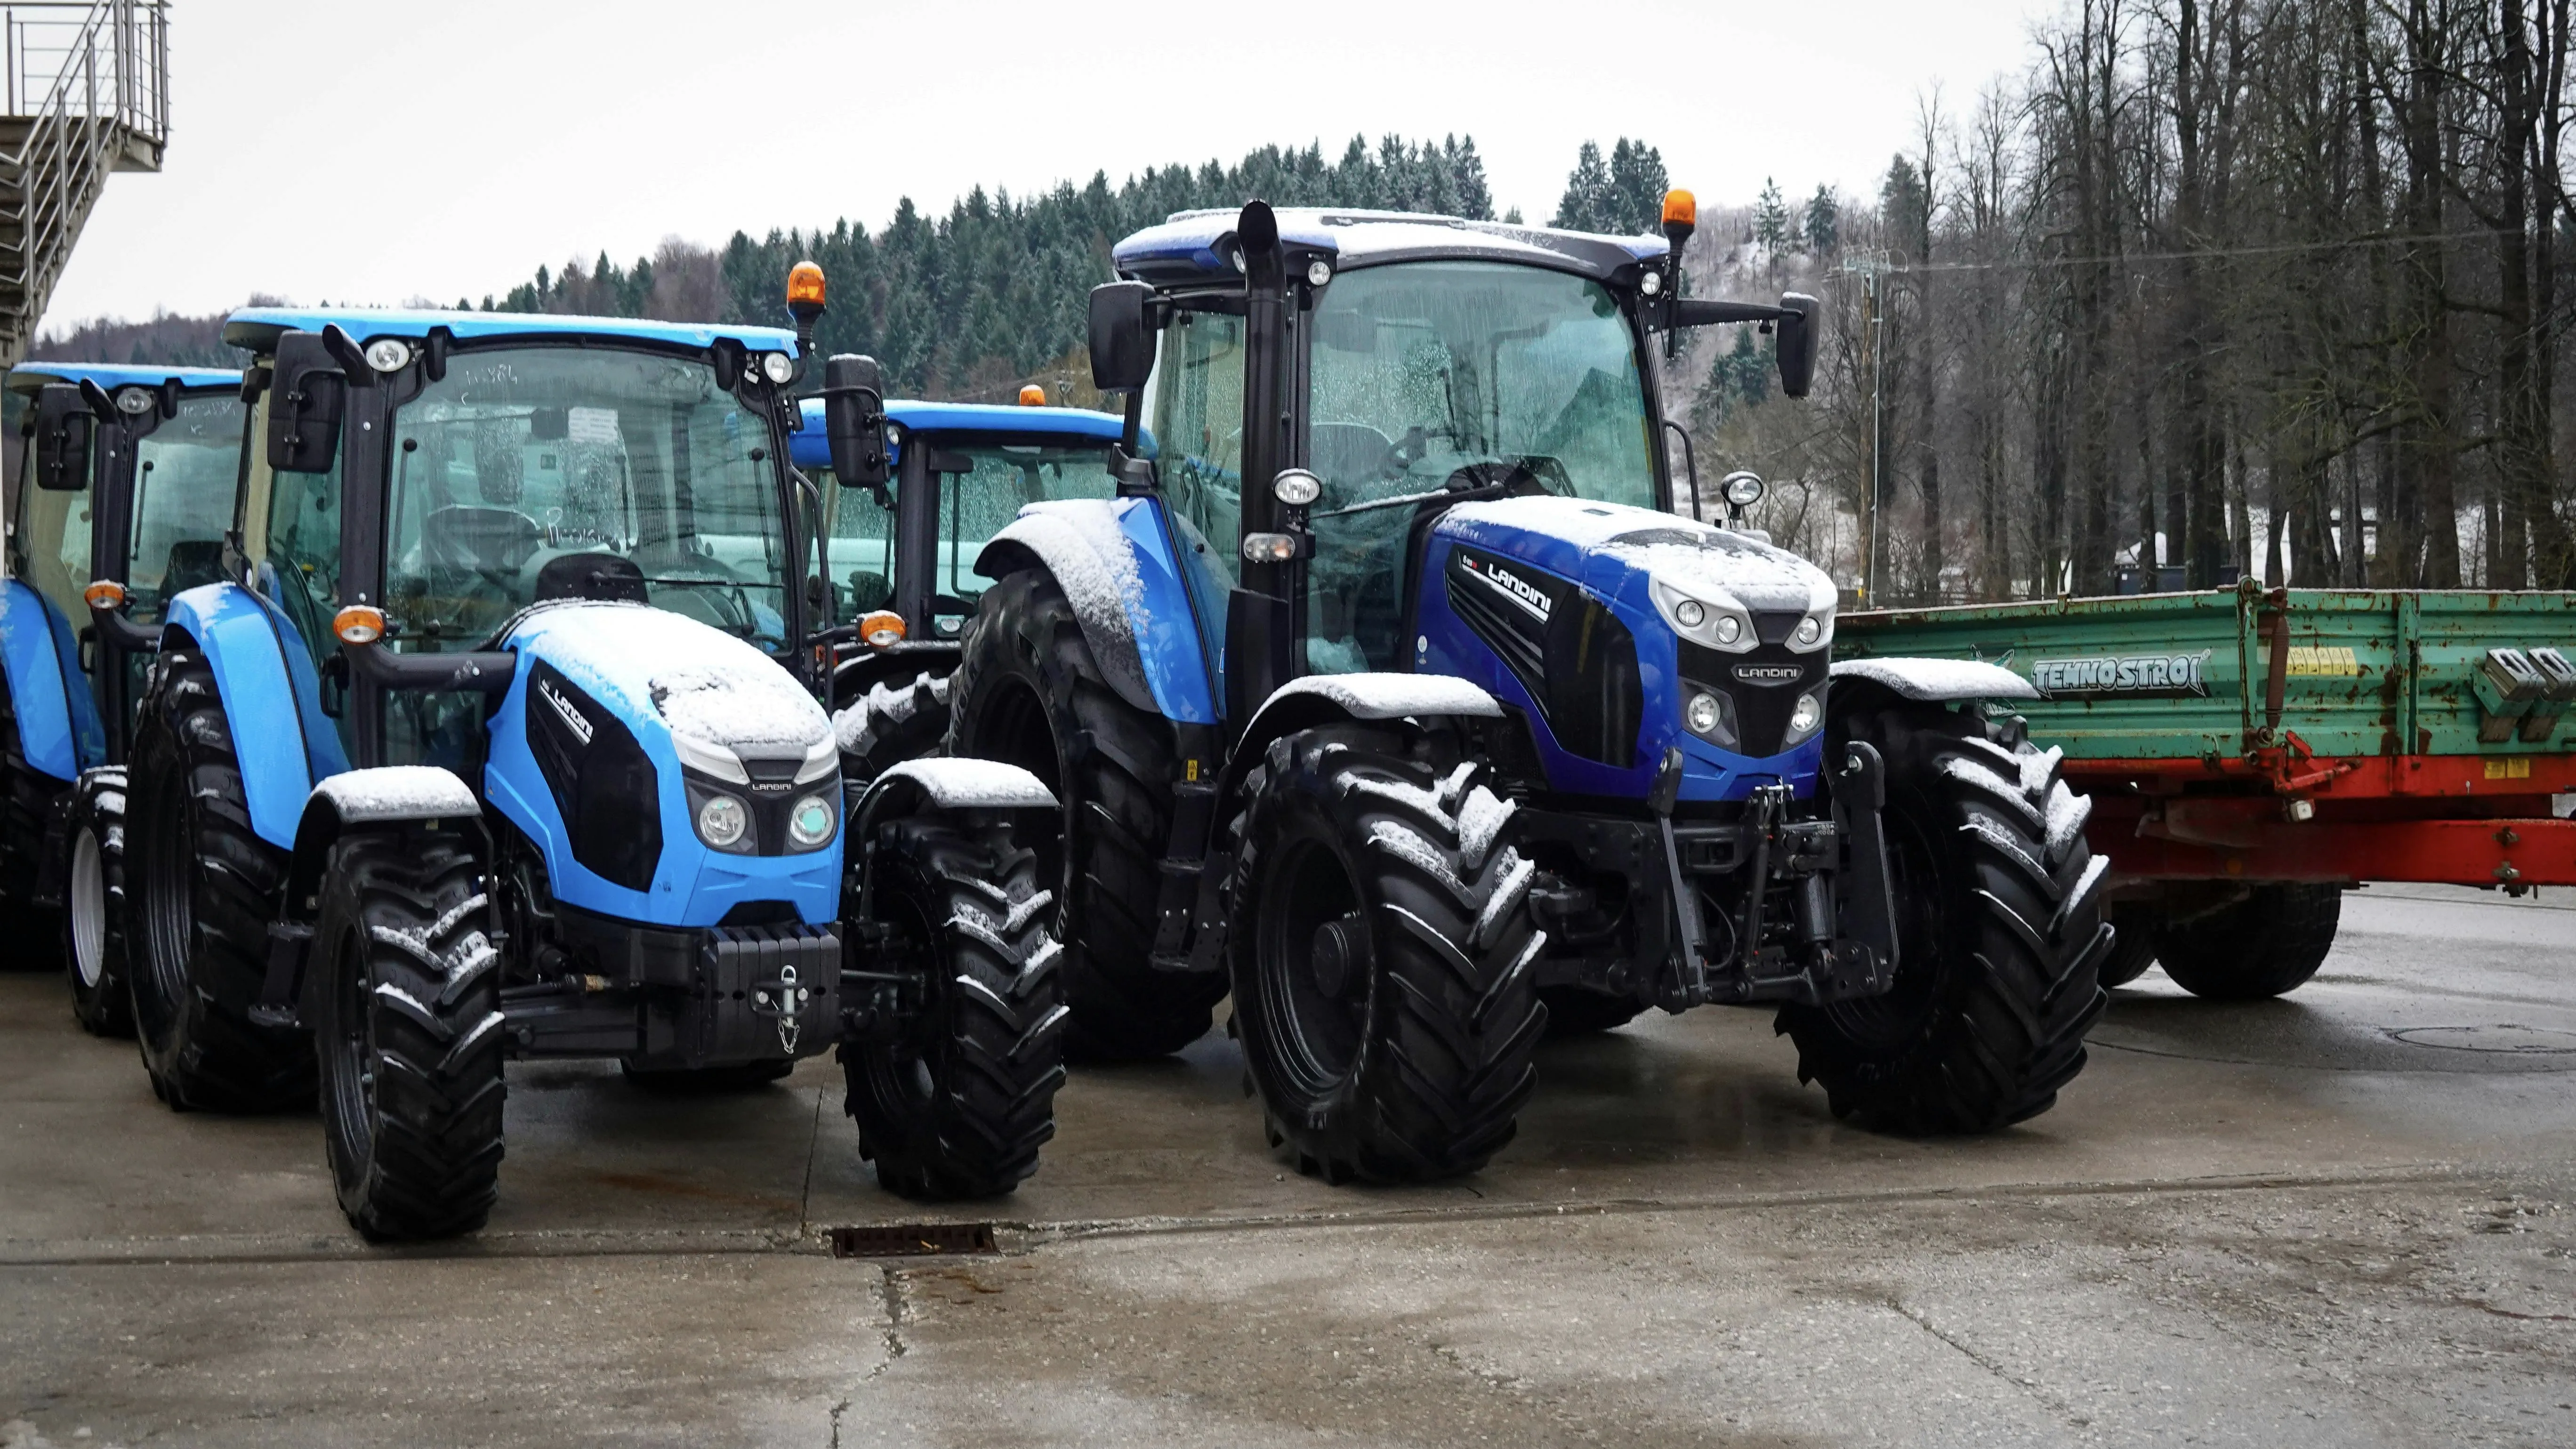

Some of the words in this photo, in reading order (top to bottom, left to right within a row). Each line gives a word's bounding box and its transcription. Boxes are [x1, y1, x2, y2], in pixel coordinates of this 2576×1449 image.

[1488, 563, 1552, 612] LANDINI
[1738, 668, 1797, 678] LANDINI
[554, 688, 594, 738] LANDINI
[752, 783, 791, 791] LANDINI
